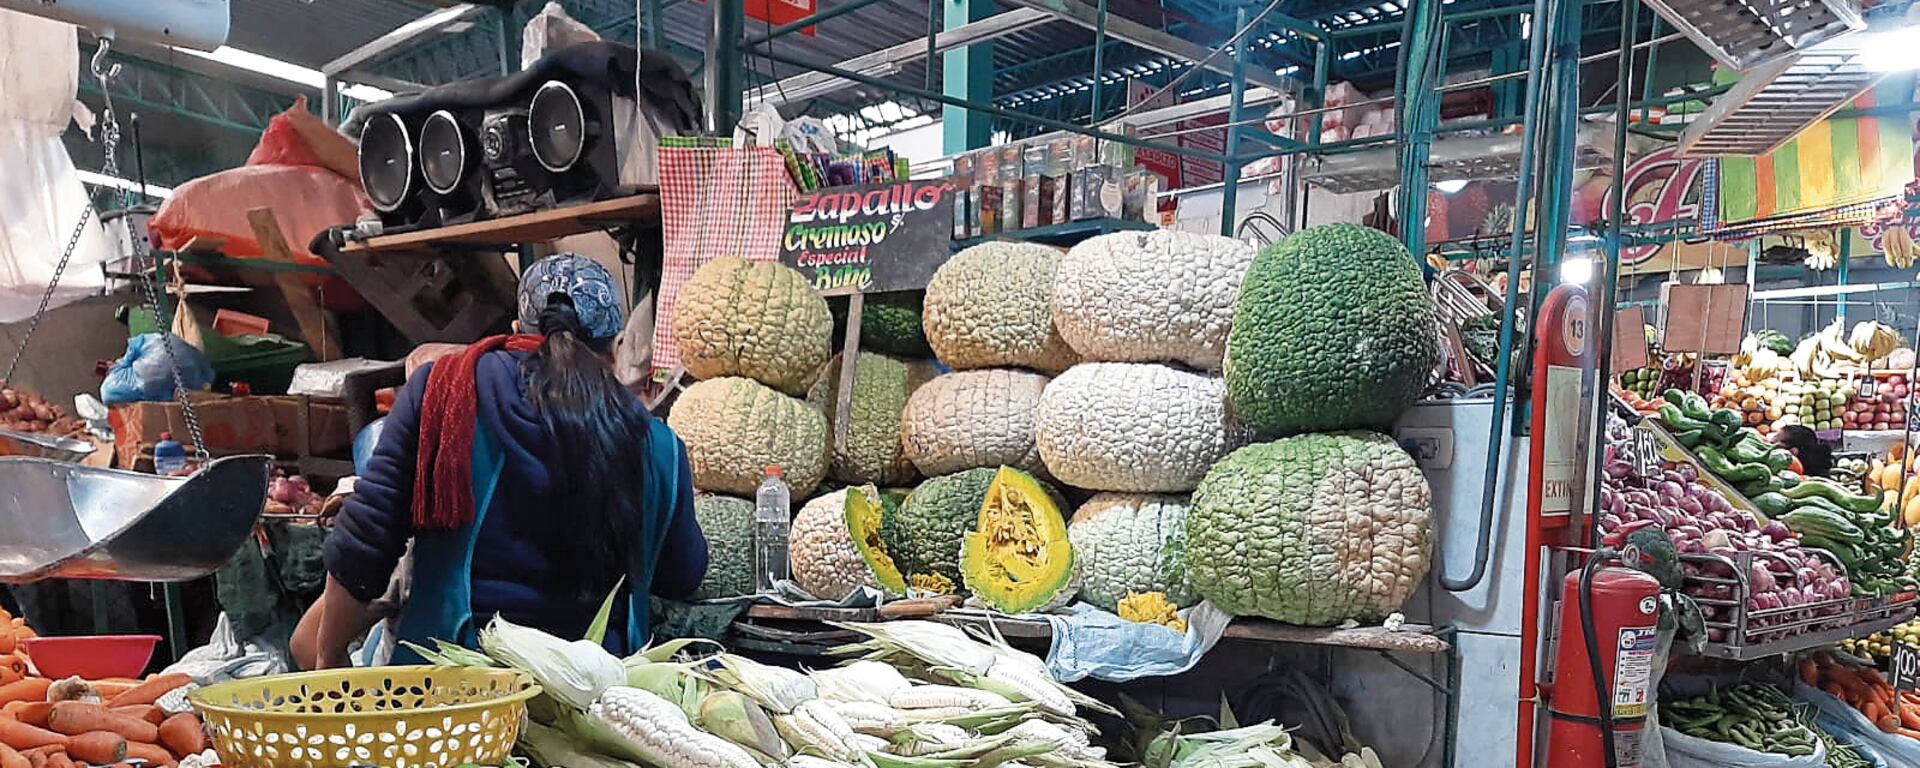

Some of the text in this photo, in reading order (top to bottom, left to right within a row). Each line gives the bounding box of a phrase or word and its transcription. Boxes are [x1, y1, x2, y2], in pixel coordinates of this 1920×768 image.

[790, 182, 957, 223] Zapallo
[785, 222, 886, 251] Cremoso
[797, 245, 869, 268] Especial
[1570, 319, 1584, 338] 13
[1546, 479, 1573, 497] EXTIN
